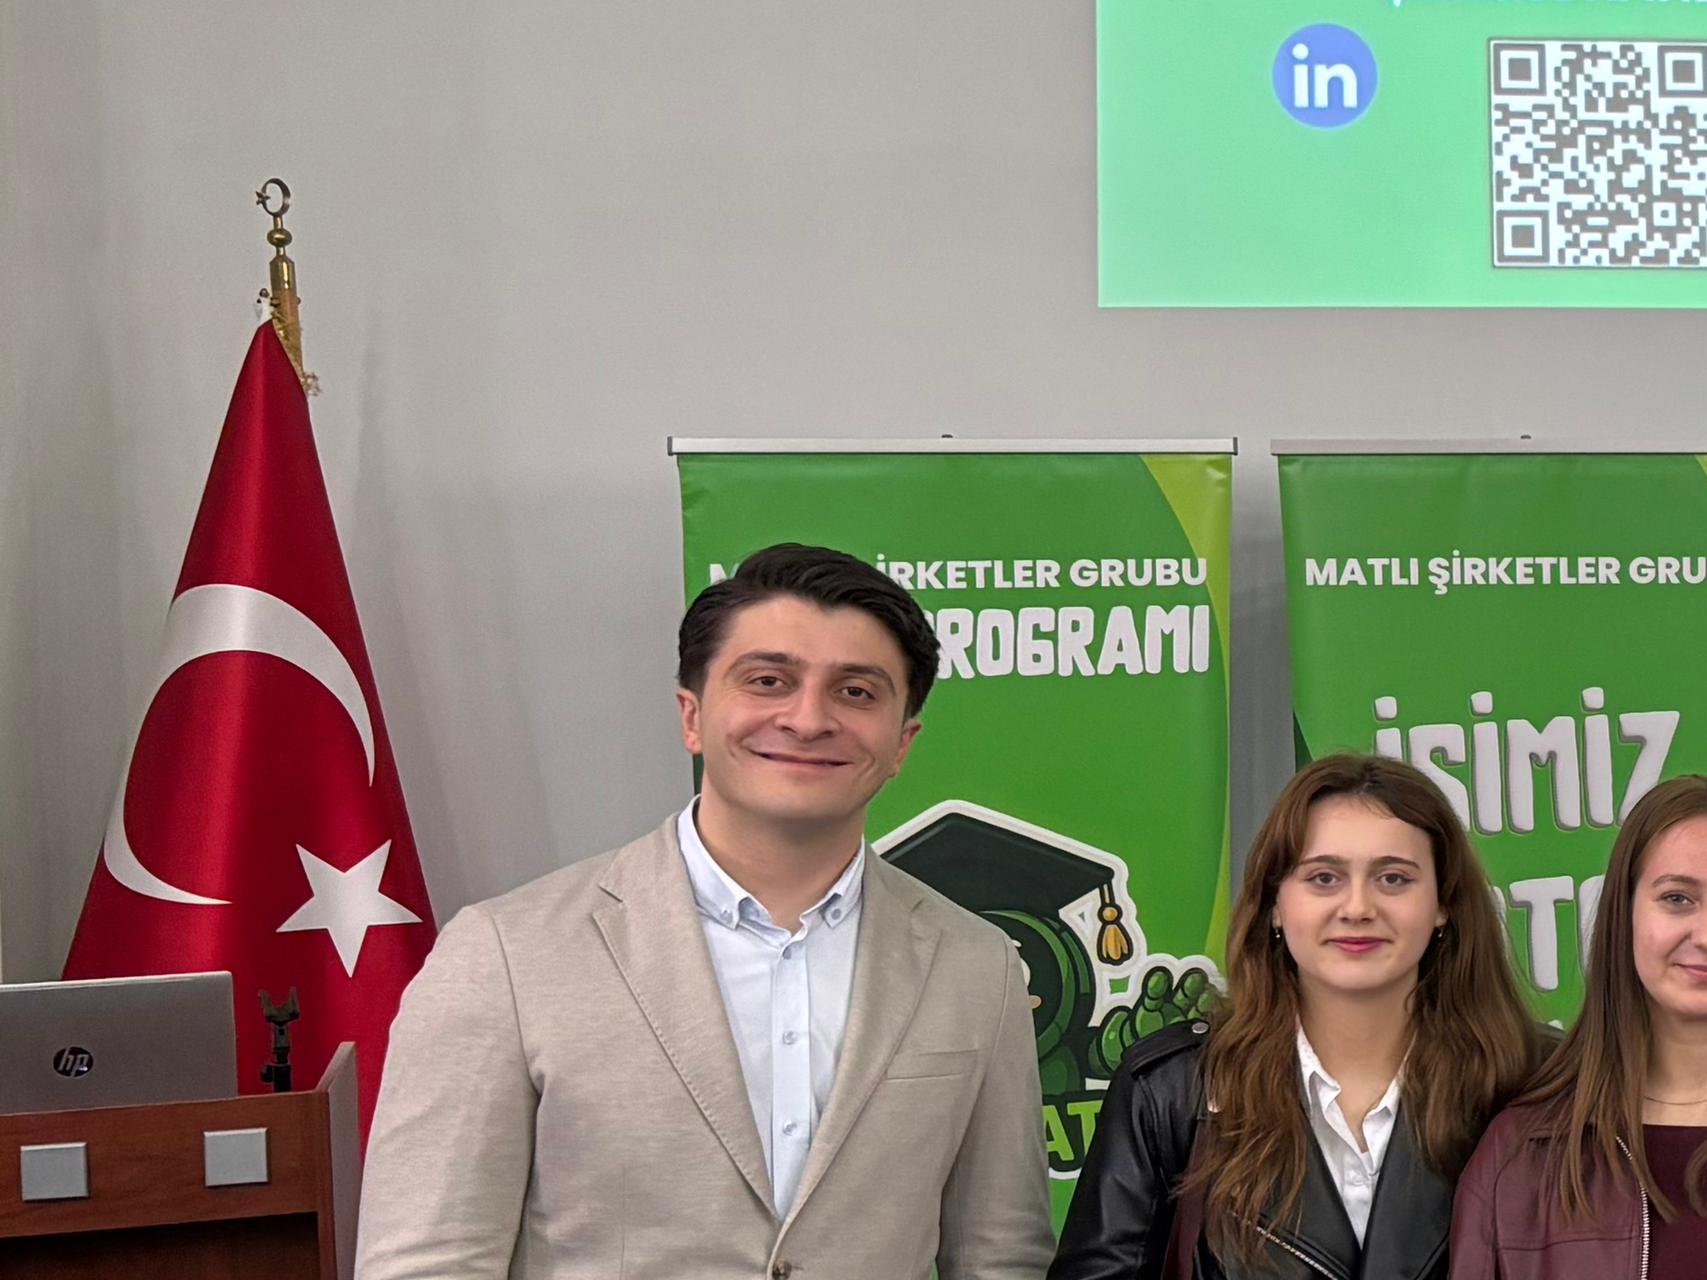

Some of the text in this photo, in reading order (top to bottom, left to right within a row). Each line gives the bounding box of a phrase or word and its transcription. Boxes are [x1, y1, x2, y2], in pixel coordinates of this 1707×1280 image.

[1291, 42, 1358, 109] in
[875, 553, 1207, 590] İRKETLER GRUBU
[1305, 556, 1419, 586] MATLI
[1428, 549, 1621, 596] ŞİRKETLER
[924, 605, 1211, 680] ROGRAMI
